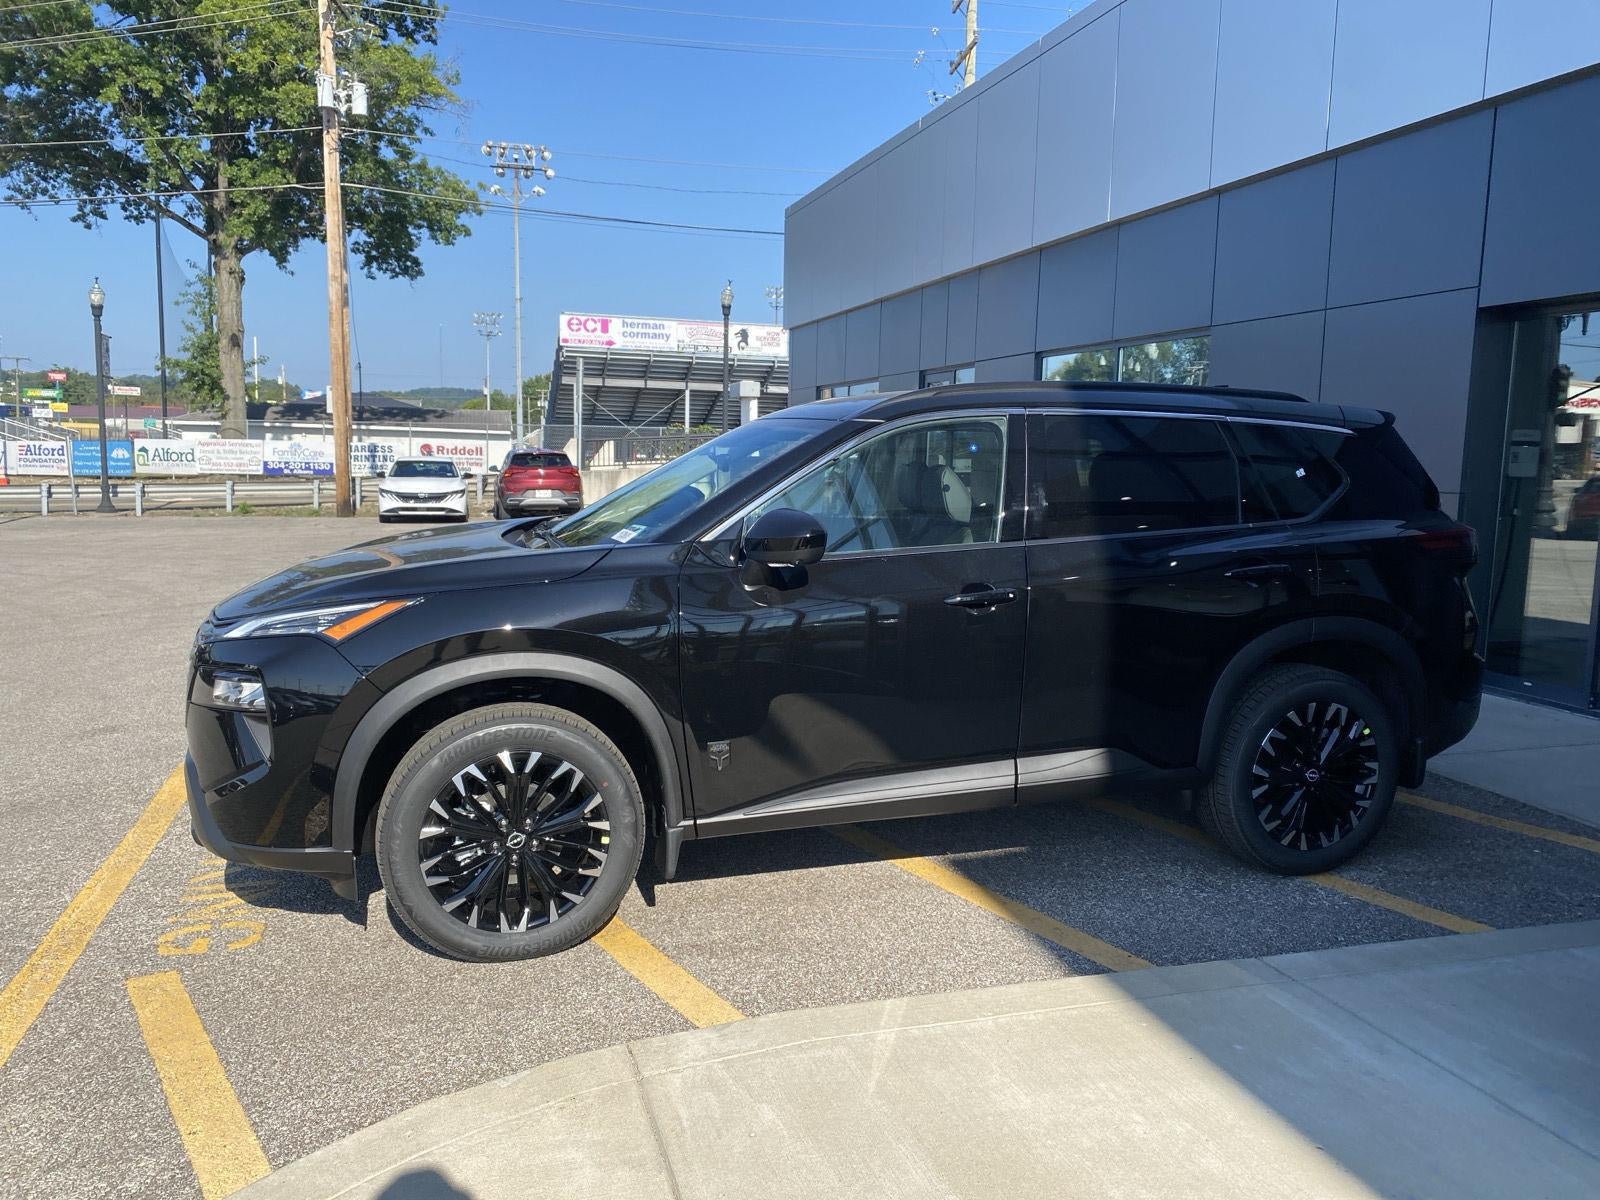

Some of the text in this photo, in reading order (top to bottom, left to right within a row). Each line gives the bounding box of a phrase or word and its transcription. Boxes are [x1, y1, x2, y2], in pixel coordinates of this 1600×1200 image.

[622, 319, 665, 330] herman
[622, 330, 671, 341] cormany
[24, 444, 65, 456] Alford
[151, 447, 196, 462] Alford
[436, 445, 483, 456] Riddell
